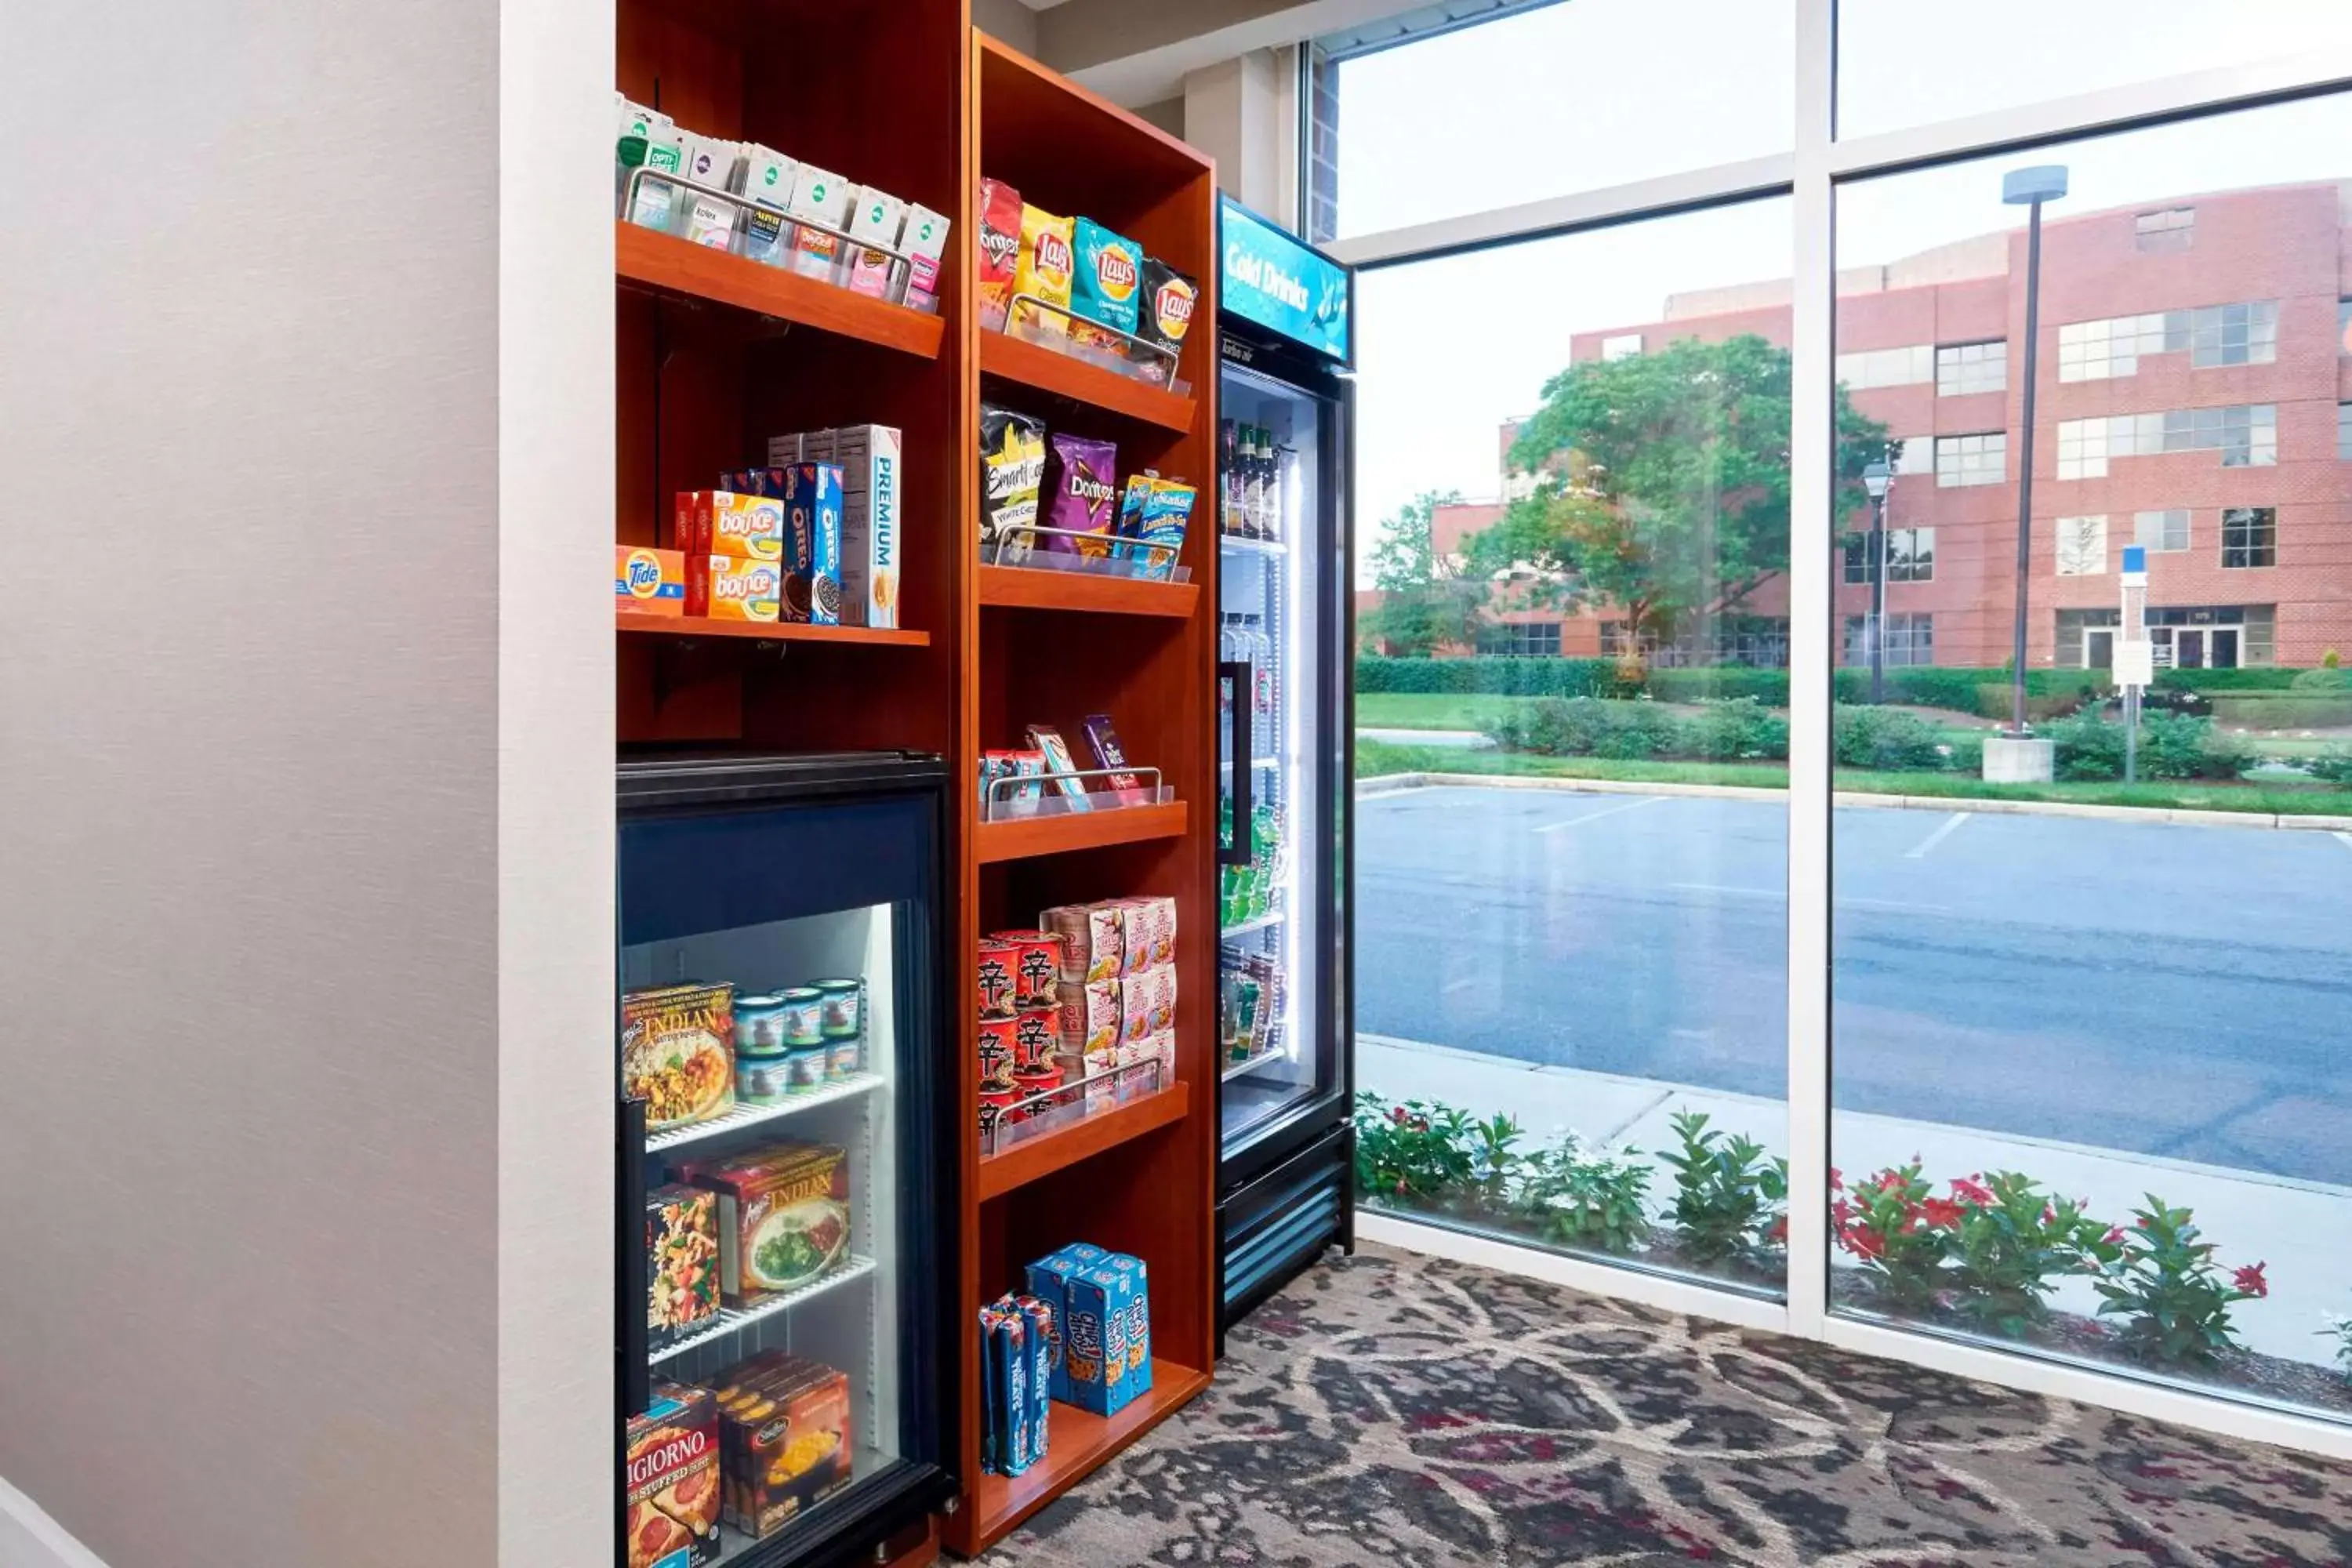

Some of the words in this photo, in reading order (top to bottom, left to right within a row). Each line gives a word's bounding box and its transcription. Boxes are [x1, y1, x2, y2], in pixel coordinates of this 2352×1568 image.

[1226, 241, 1262, 289] Cold
[1262, 260, 1309, 313] Drinks
[1071, 475, 1113, 501] Doritos
[720, 510, 774, 534] bounce
[877, 457, 891, 566] PREMIUM
[793, 508, 807, 570] OREO
[823, 509, 836, 571] OREO
[630, 561, 659, 587] Tide
[717, 574, 771, 598] bounce
[1021, 949, 1051, 993] 辛
[644, 1008, 717, 1042] INDIAN
[1018, 1019, 1049, 1066] 辛
[769, 1174, 832, 1213] INDIAN
[627, 1432, 705, 1483] IGIORNO
[639, 1467, 688, 1499] STUFFED
